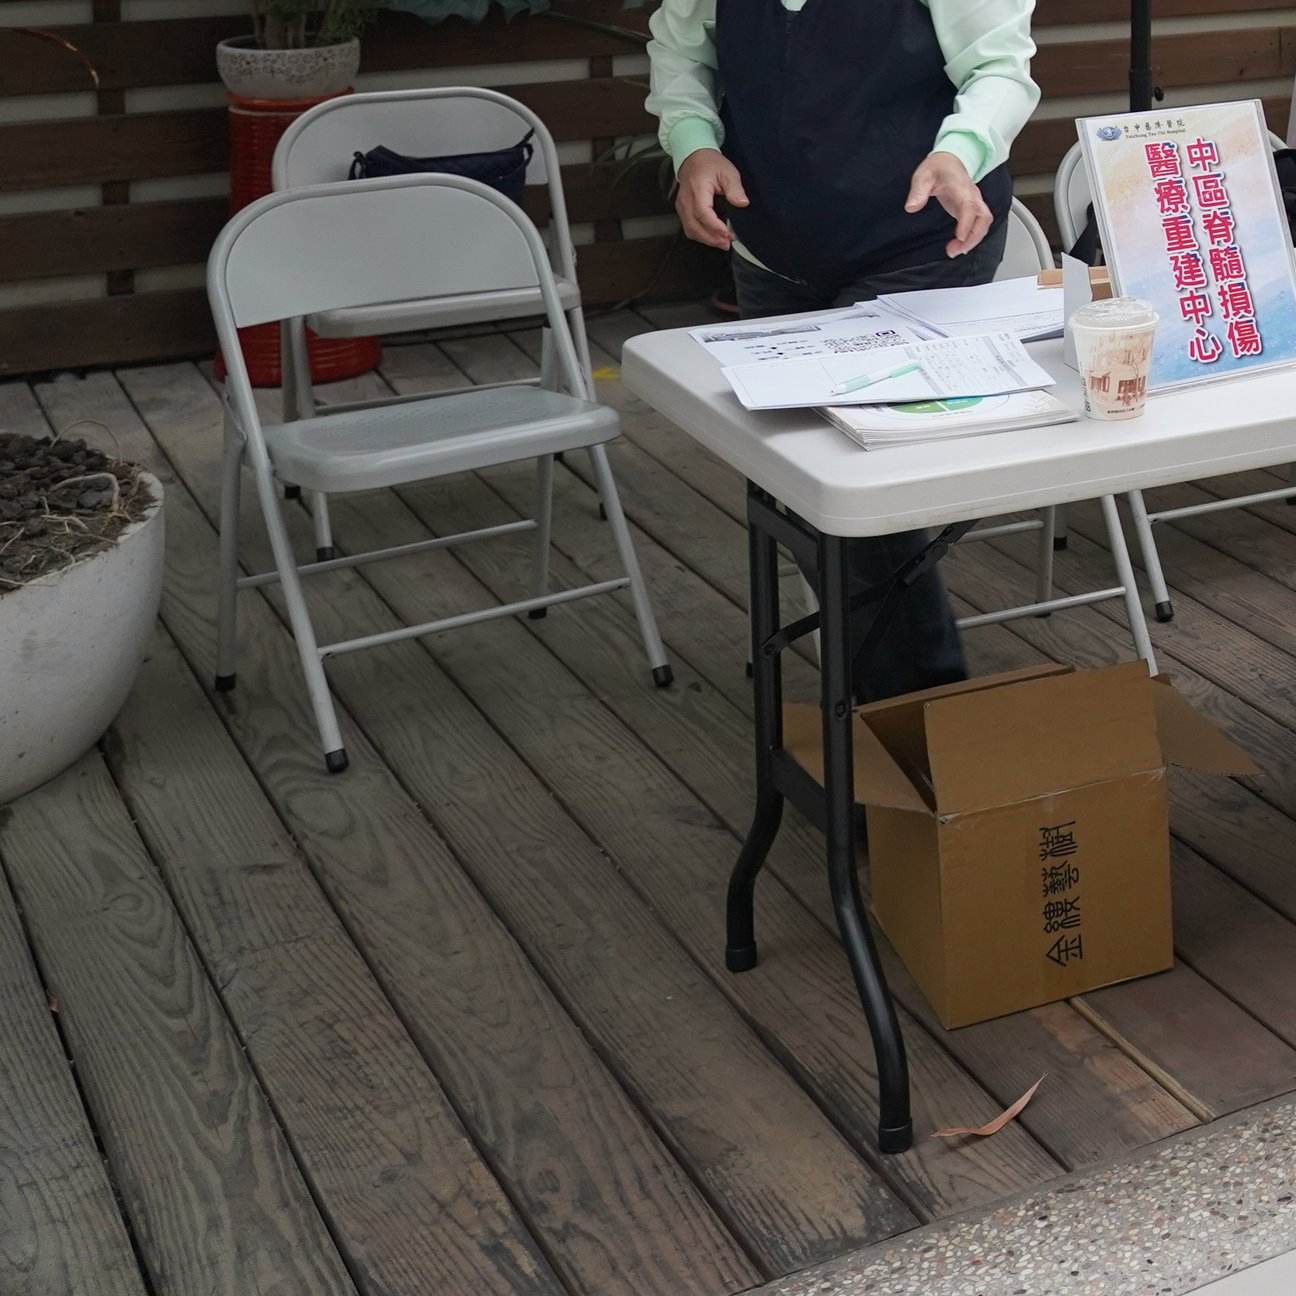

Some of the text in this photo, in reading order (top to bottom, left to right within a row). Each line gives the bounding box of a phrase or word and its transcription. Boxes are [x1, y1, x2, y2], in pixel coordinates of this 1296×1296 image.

[1144, 142, 1221, 362] 醫療重建中心
[1186, 138, 1262, 357] 中區脊髓損傷
